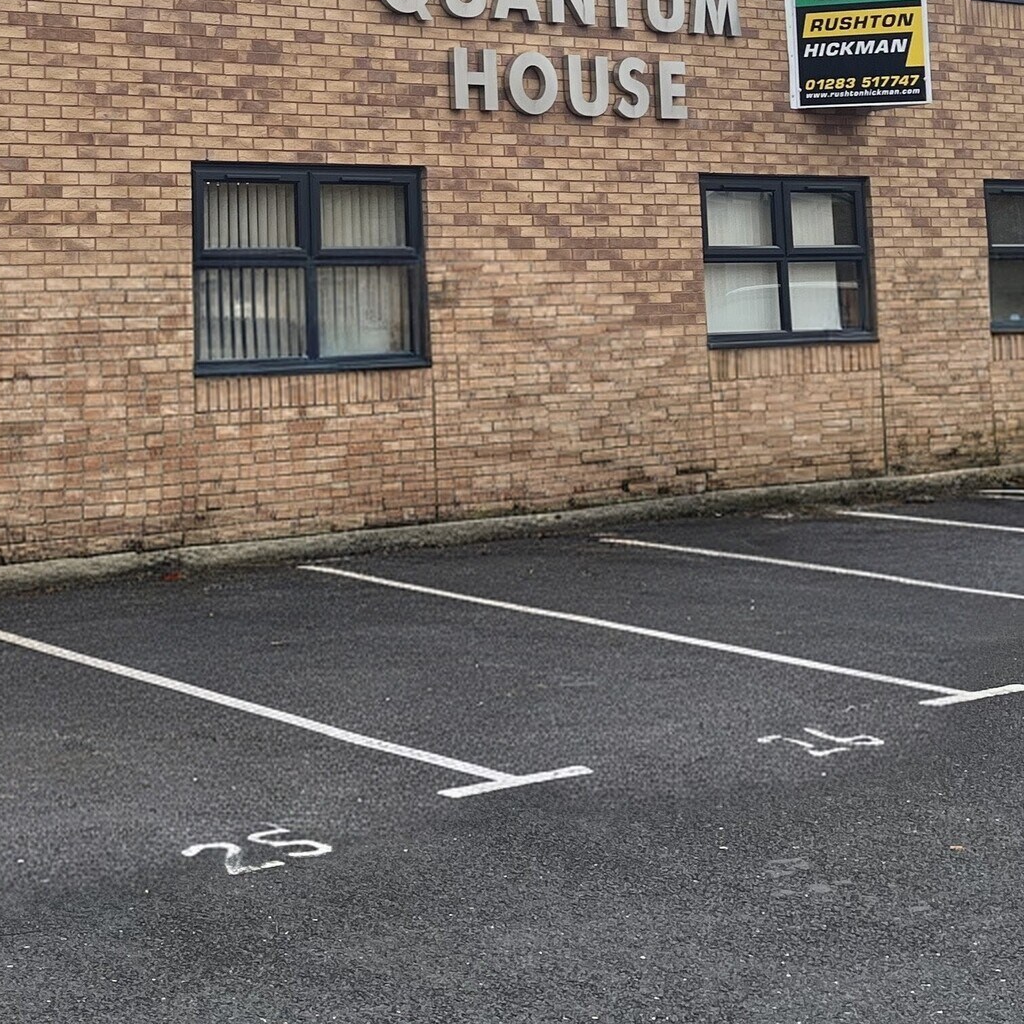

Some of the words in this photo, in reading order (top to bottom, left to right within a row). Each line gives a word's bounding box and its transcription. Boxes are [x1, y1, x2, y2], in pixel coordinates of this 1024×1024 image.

[810, 13, 914, 32] RUSHTON
[804, 38, 908, 58] HICKMAN
[449, 46, 689, 120] HOUSE
[805, 77, 856, 91] 01283
[861, 74, 920, 88] 517747
[806, 88, 921, 99] www.rushtonhickman.com
[181, 822, 332, 875] 25
